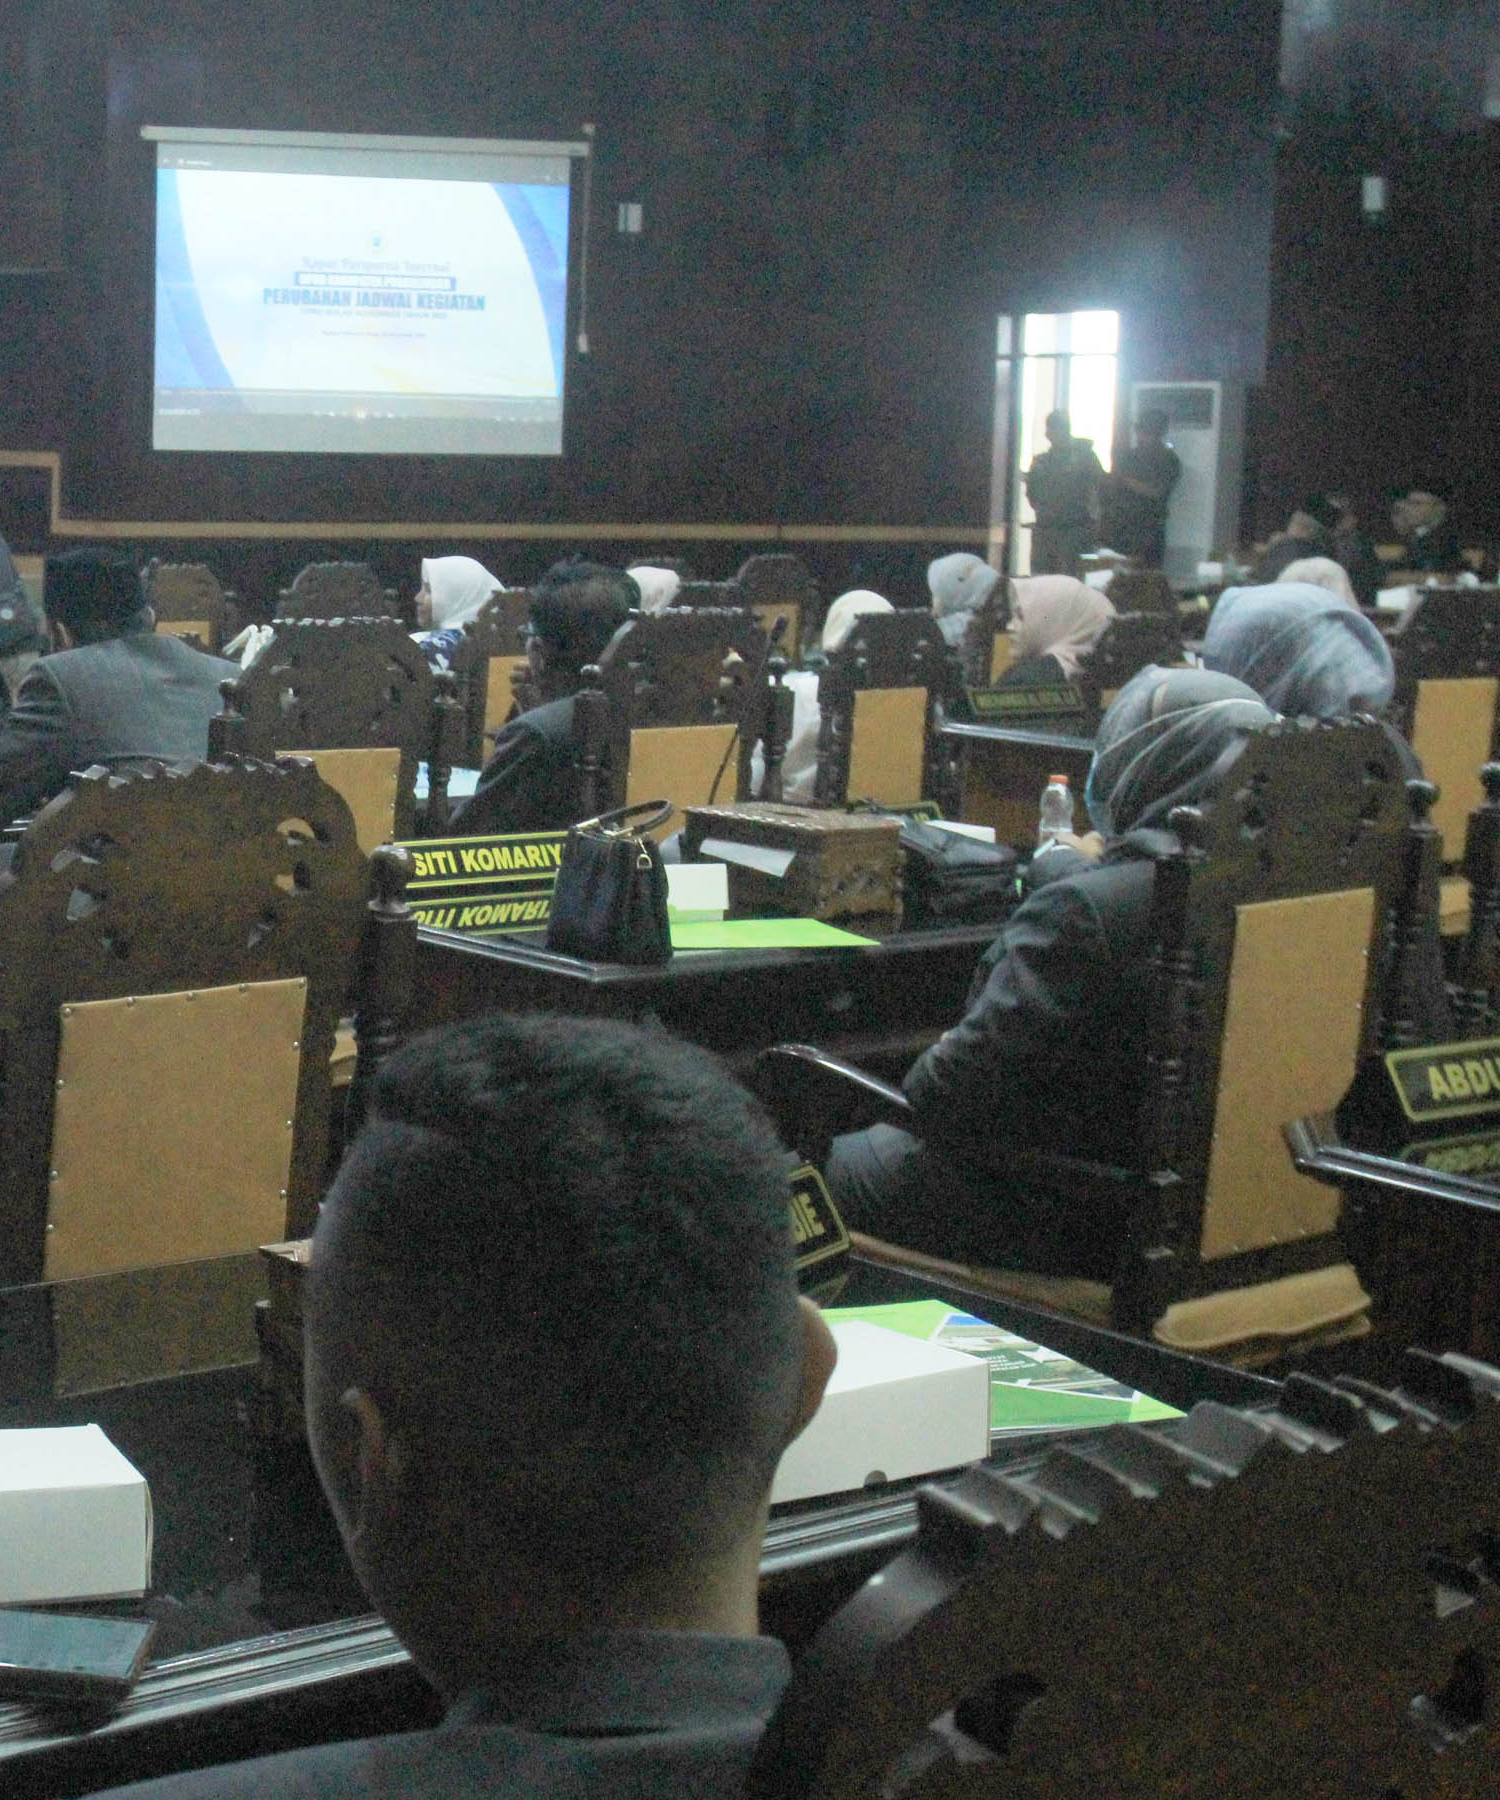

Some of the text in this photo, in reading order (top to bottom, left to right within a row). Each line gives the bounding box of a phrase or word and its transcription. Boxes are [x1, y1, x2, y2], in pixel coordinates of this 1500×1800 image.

[263, 287, 485, 311] PERUBAHAN JADWAL KEGIATAN
[412, 843, 566, 876] SITI KOMARIY
